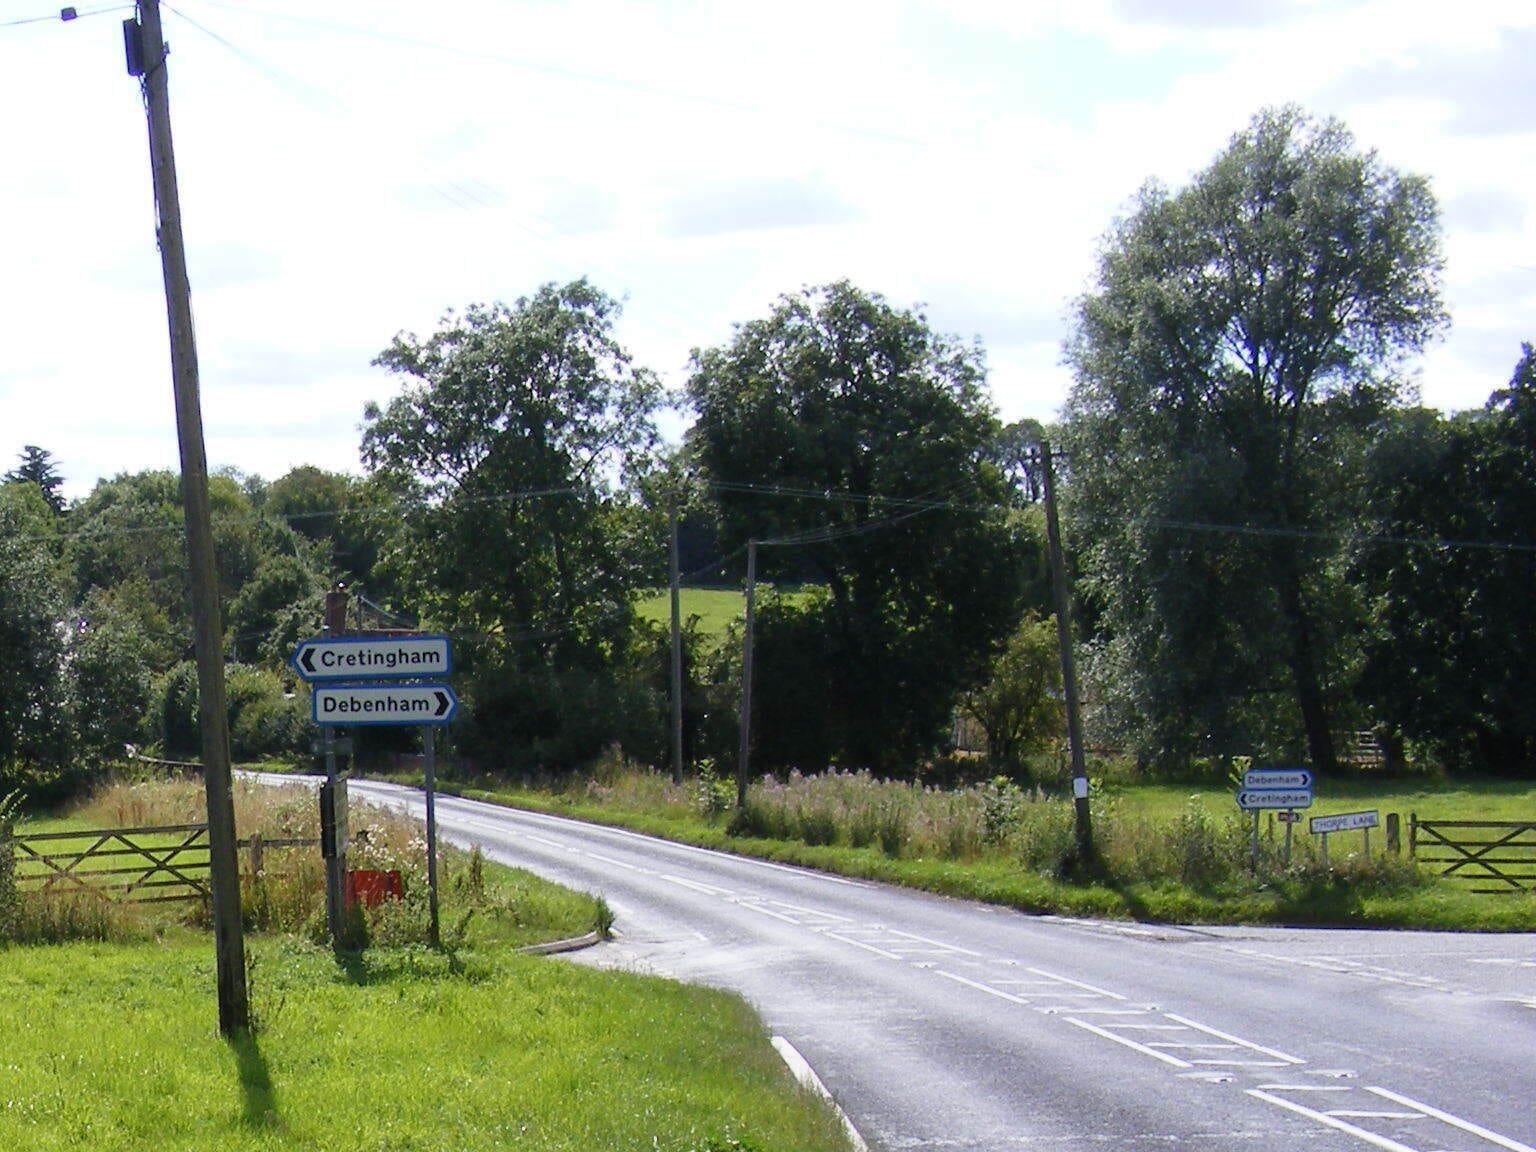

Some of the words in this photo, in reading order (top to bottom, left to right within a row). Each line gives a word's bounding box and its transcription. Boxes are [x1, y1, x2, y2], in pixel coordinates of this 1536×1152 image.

[321, 648, 440, 668] Cretingham
[323, 696, 430, 713] Debenham
[1247, 775, 1300, 784] Debenham
[1248, 794, 1309, 804] Cretingham
